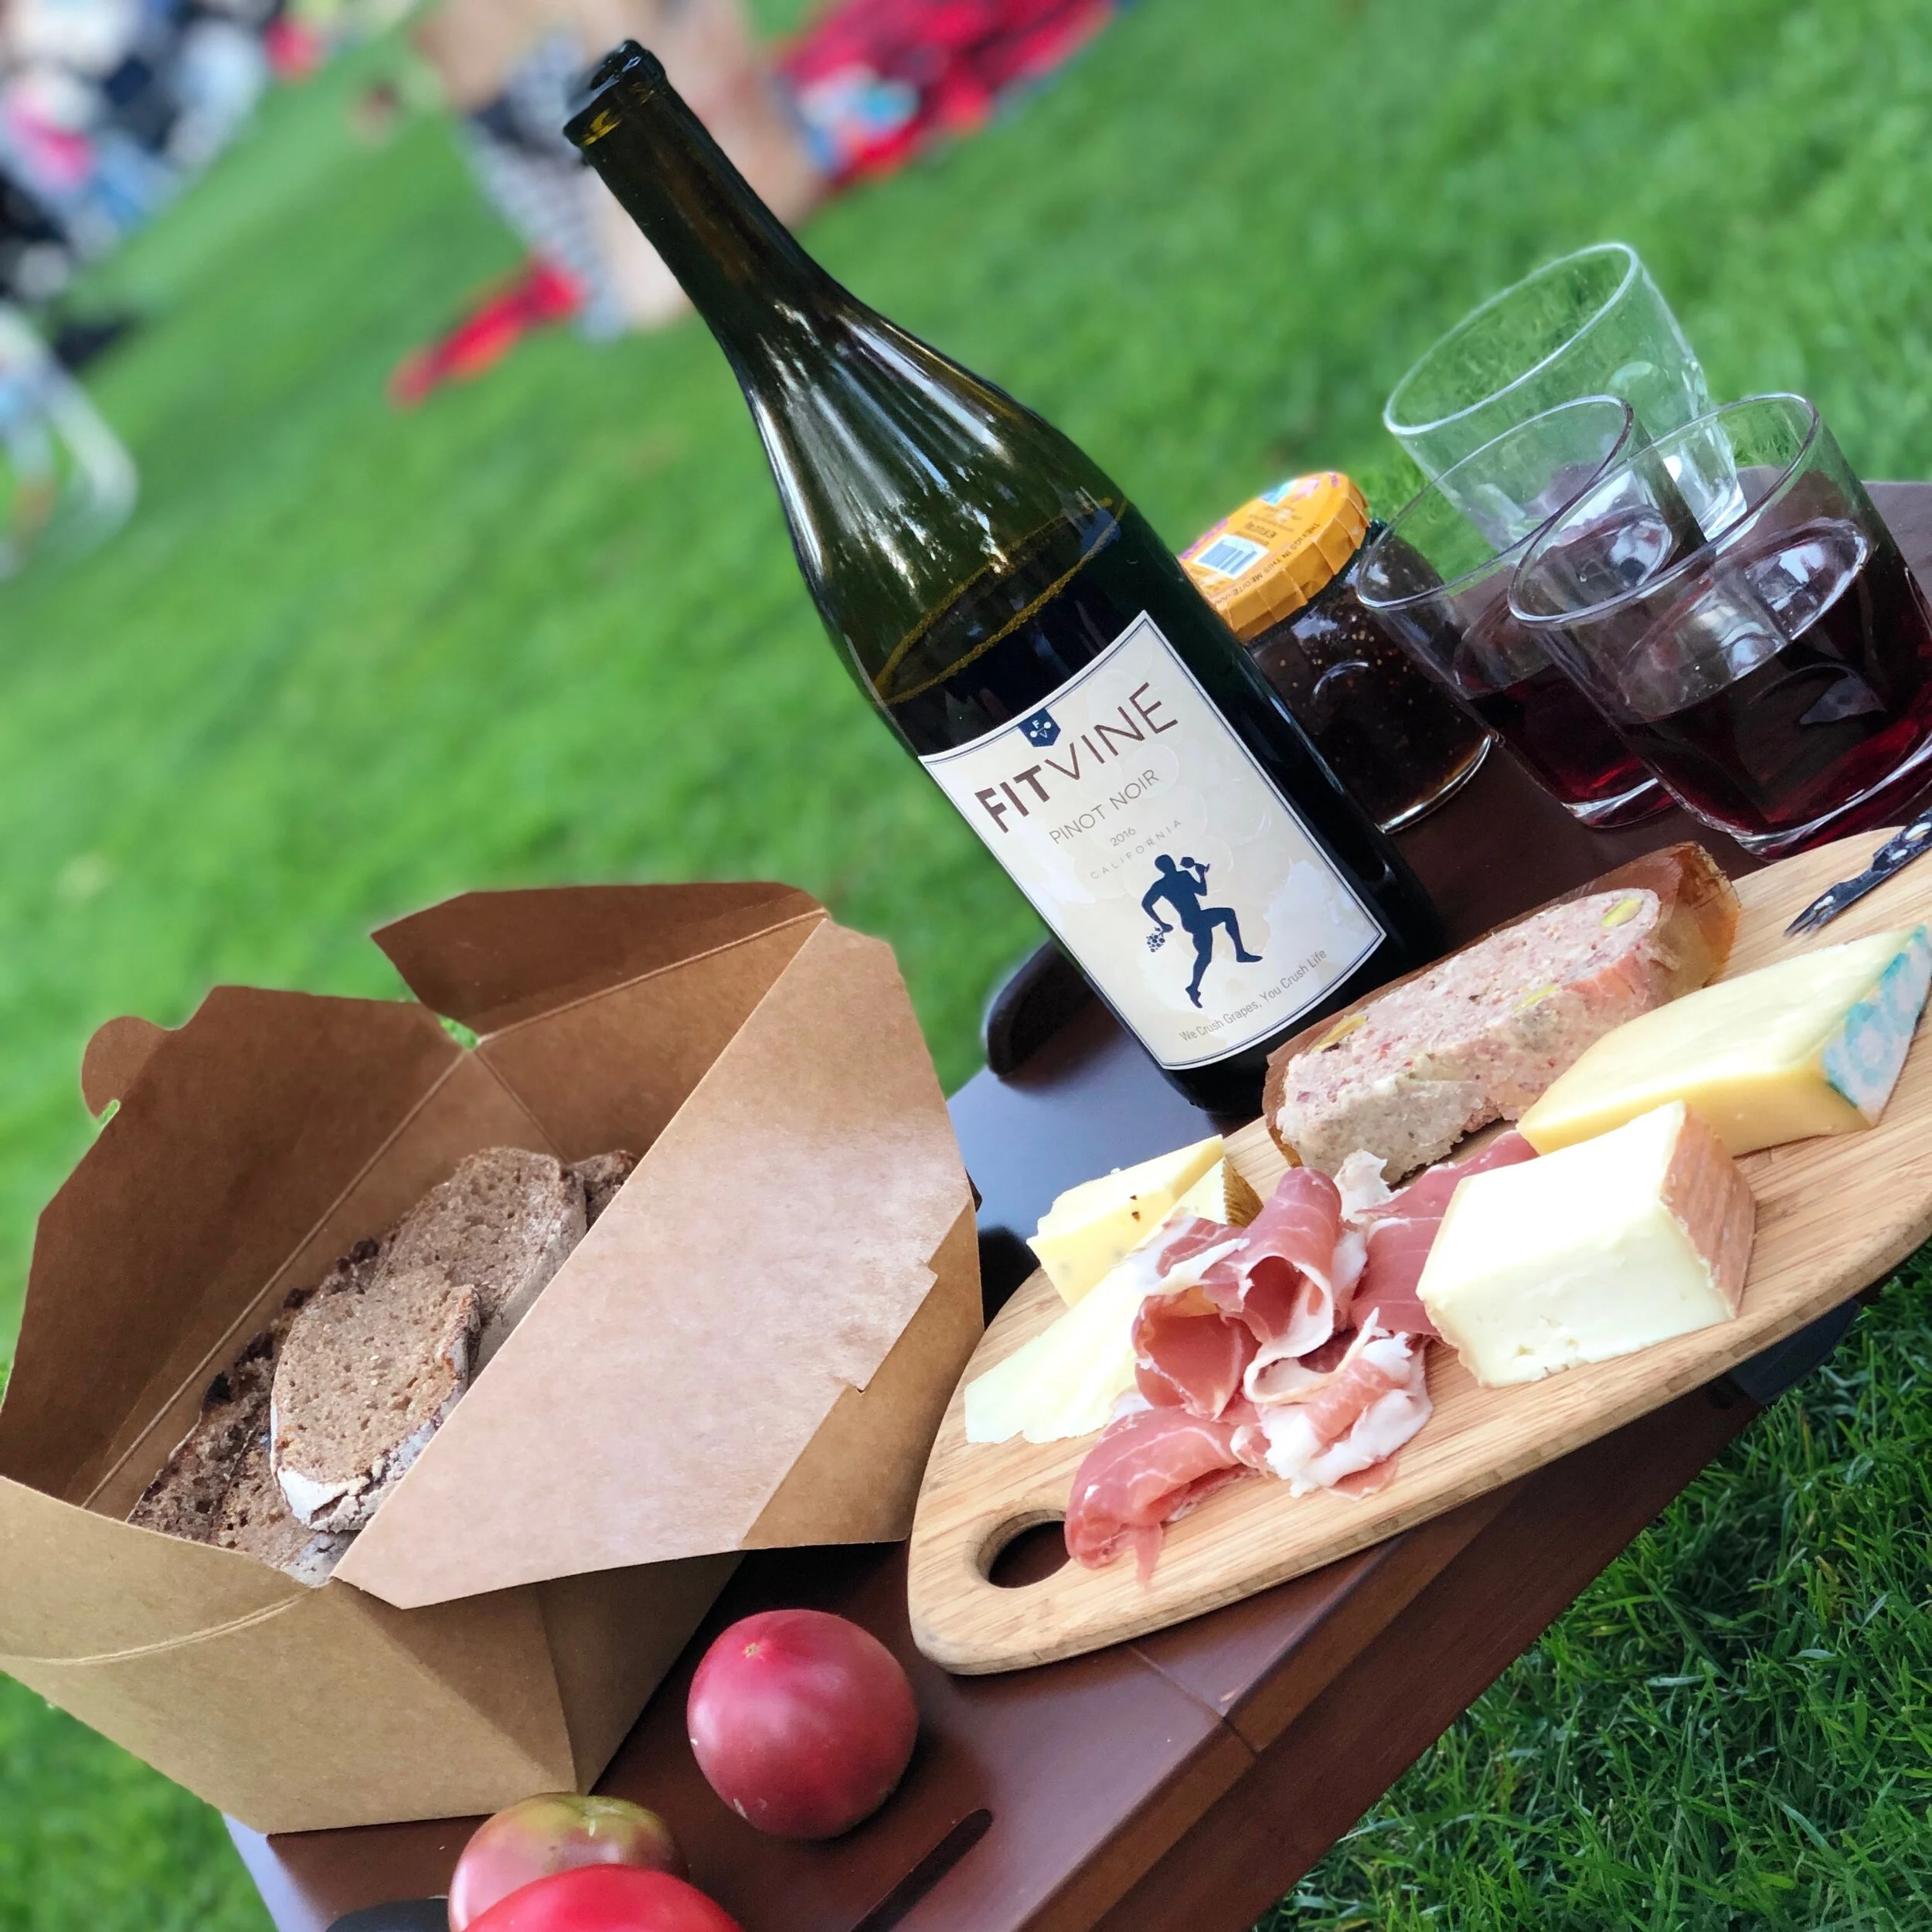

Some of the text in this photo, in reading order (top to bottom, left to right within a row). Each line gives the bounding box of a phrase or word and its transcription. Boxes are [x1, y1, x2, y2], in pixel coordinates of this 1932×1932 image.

[1281, 550, 1292, 559] IN
[1264, 558, 1282, 573] THIS
[1032, 719, 1040, 729] F
[1039, 730, 1048, 739] V
[1049, 769, 1159, 845] PINOT NOIR
[1110, 827, 1136, 847] 2016
[1090, 819, 1182, 879] CALIFORNIA
[1179, 948, 1327, 1042] We Crush Grapes, You Crush Life
